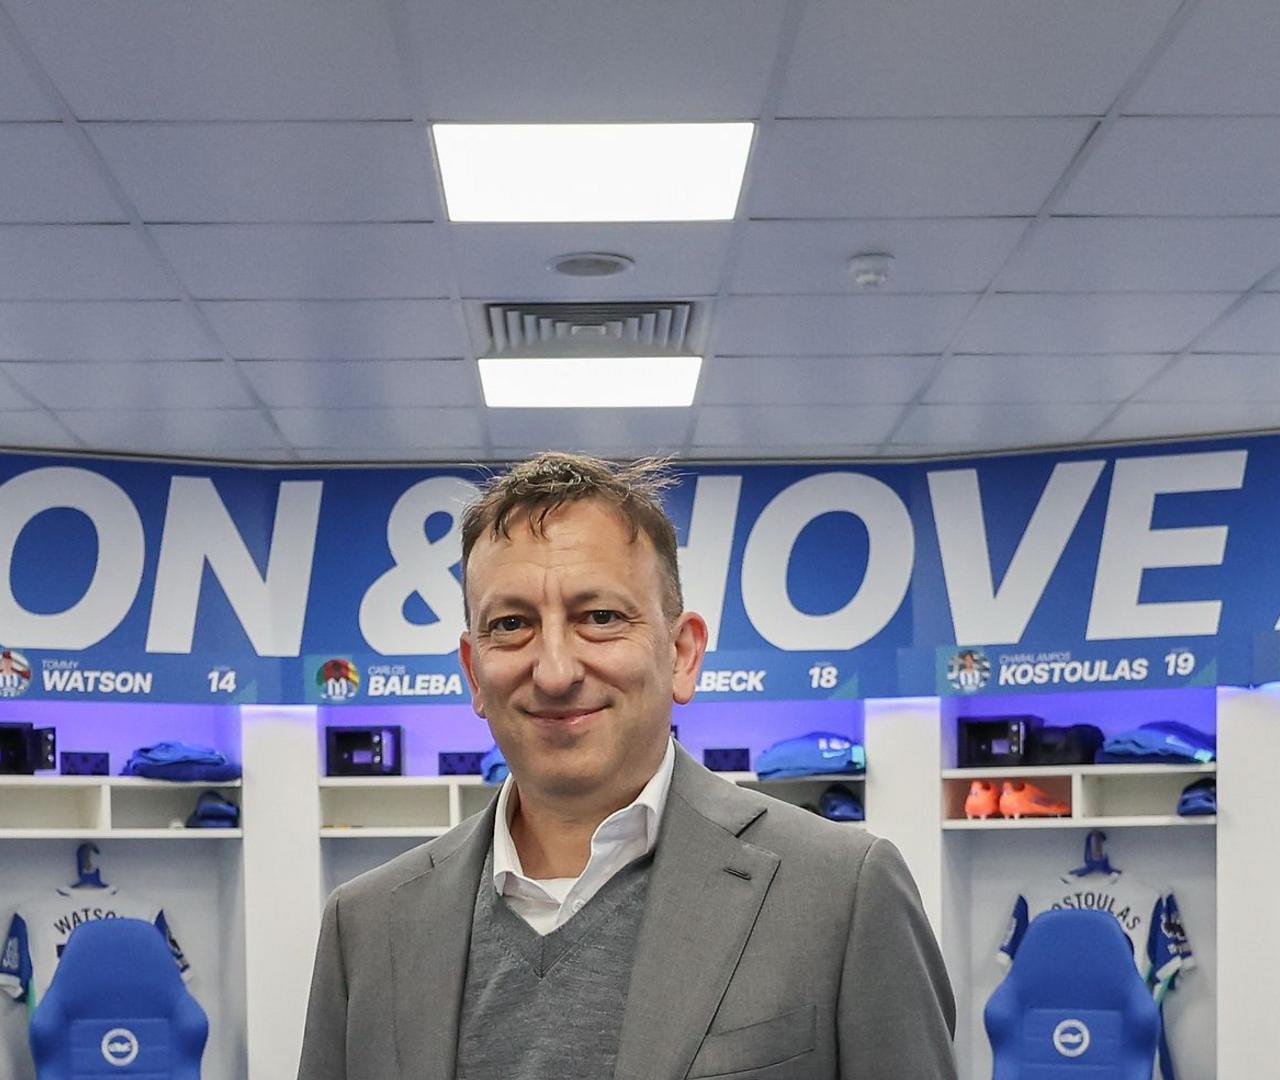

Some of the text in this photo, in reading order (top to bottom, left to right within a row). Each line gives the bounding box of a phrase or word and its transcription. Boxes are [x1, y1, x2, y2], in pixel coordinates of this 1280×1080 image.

[358, 475, 484, 656] &
[809, 666, 838, 689] 18
[999, 652, 1195, 686] KOSTOULAS 19
[42, 670, 153, 694] WATSON
[207, 670, 237, 693] 14
[368, 673, 463, 696] BALEBA
[695, 670, 767, 693] BECK
